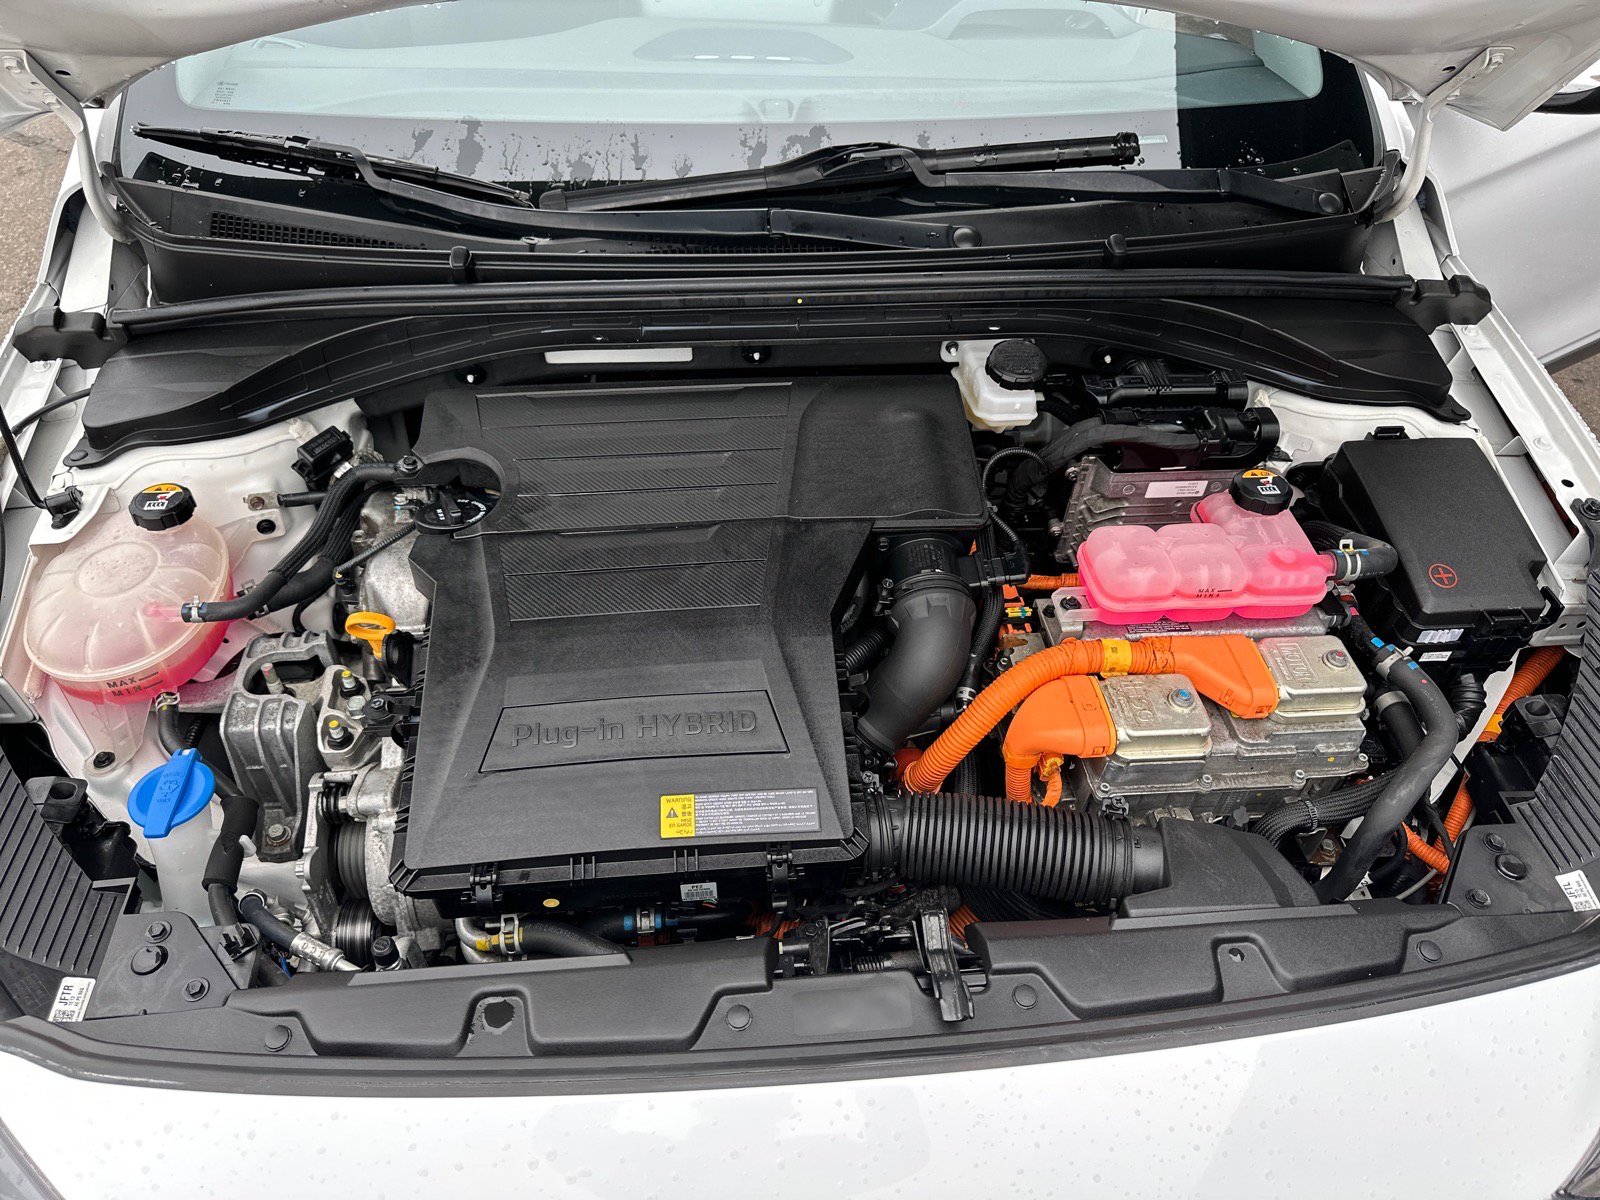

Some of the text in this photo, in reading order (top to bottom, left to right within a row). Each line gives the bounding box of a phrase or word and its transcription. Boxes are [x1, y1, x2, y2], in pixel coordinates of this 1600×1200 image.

[1280, 647, 1312, 680] MOTOR
[107, 676, 138, 688] MAX
[111, 685, 143, 697] MIN
[511, 709, 758, 748] Plug-in HYBRID
[1562, 881, 1578, 899] JFTL
[58, 985, 74, 1006] JFTR
